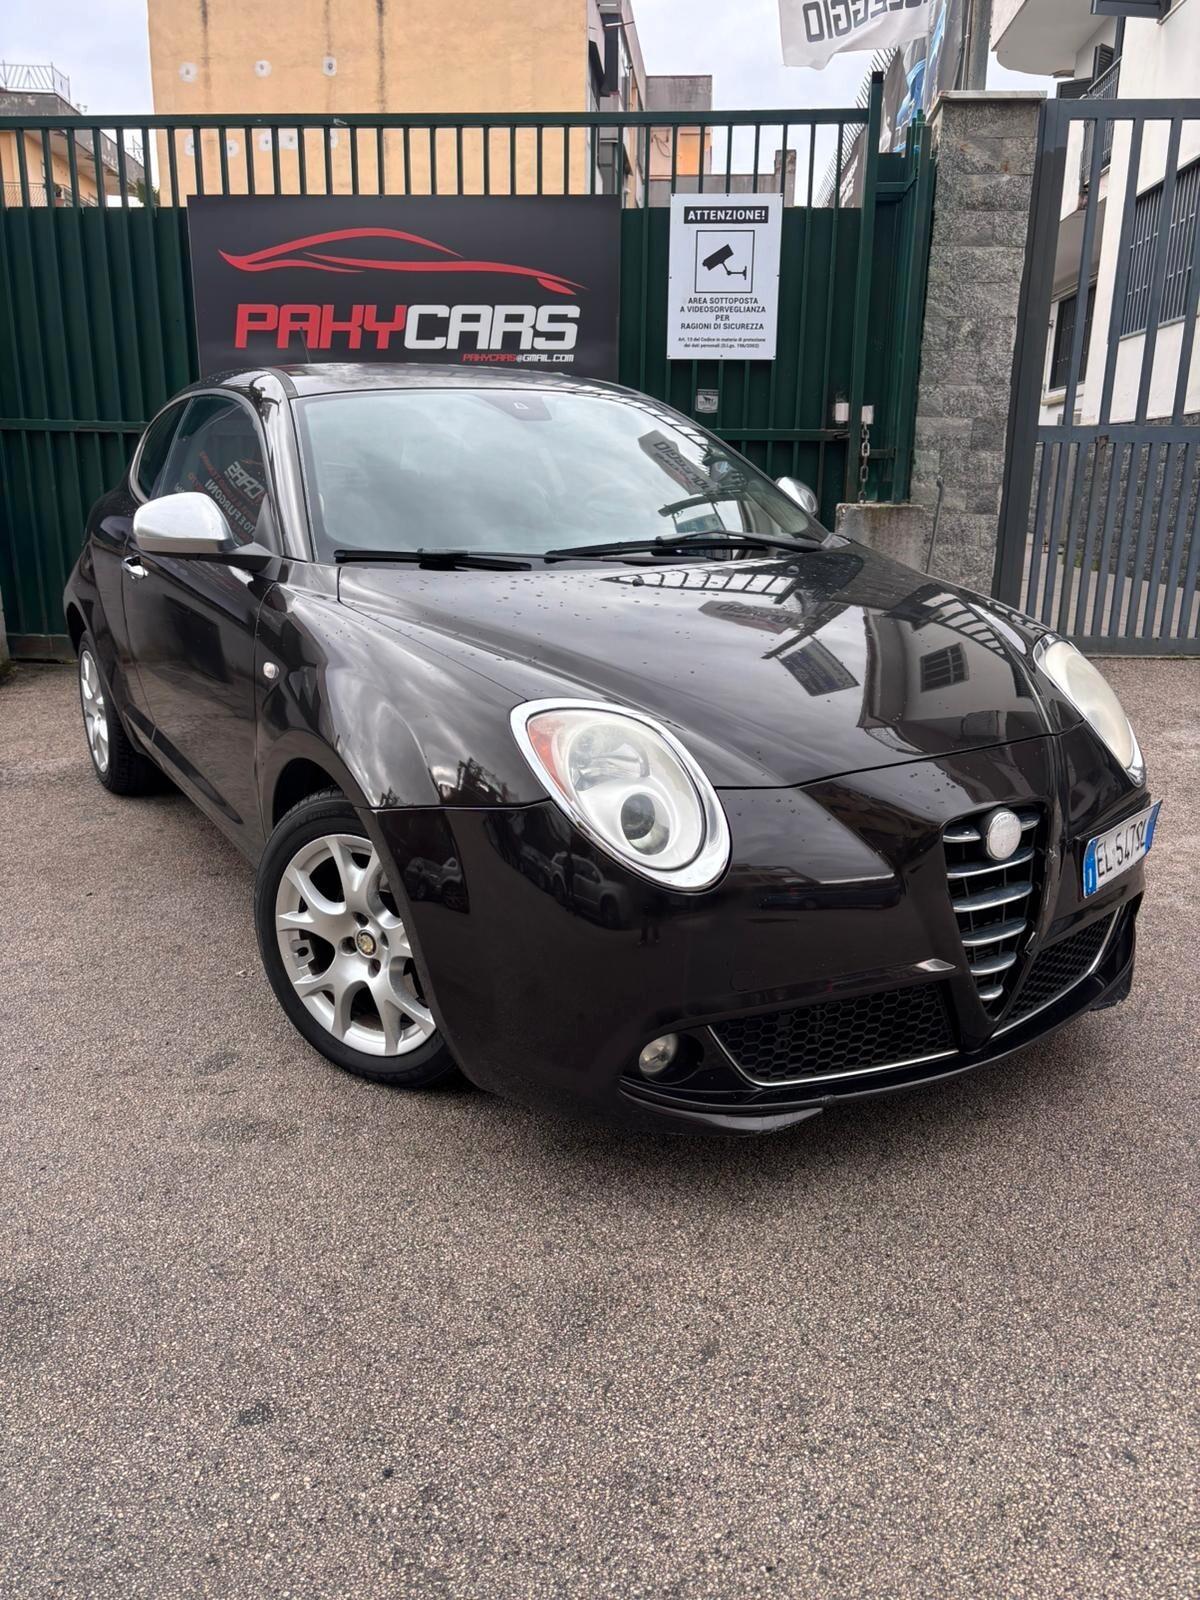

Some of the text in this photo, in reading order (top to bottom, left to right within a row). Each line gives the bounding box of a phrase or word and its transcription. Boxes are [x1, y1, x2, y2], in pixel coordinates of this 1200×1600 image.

[688, 209, 765, 220] ATTENZIONE!
[687, 305, 766, 313] VIDEOSORVEGLIANZA
[234, 303, 581, 350] PAKYCARS
[680, 322, 764, 330] RAGIONI DI SICUREZZA
